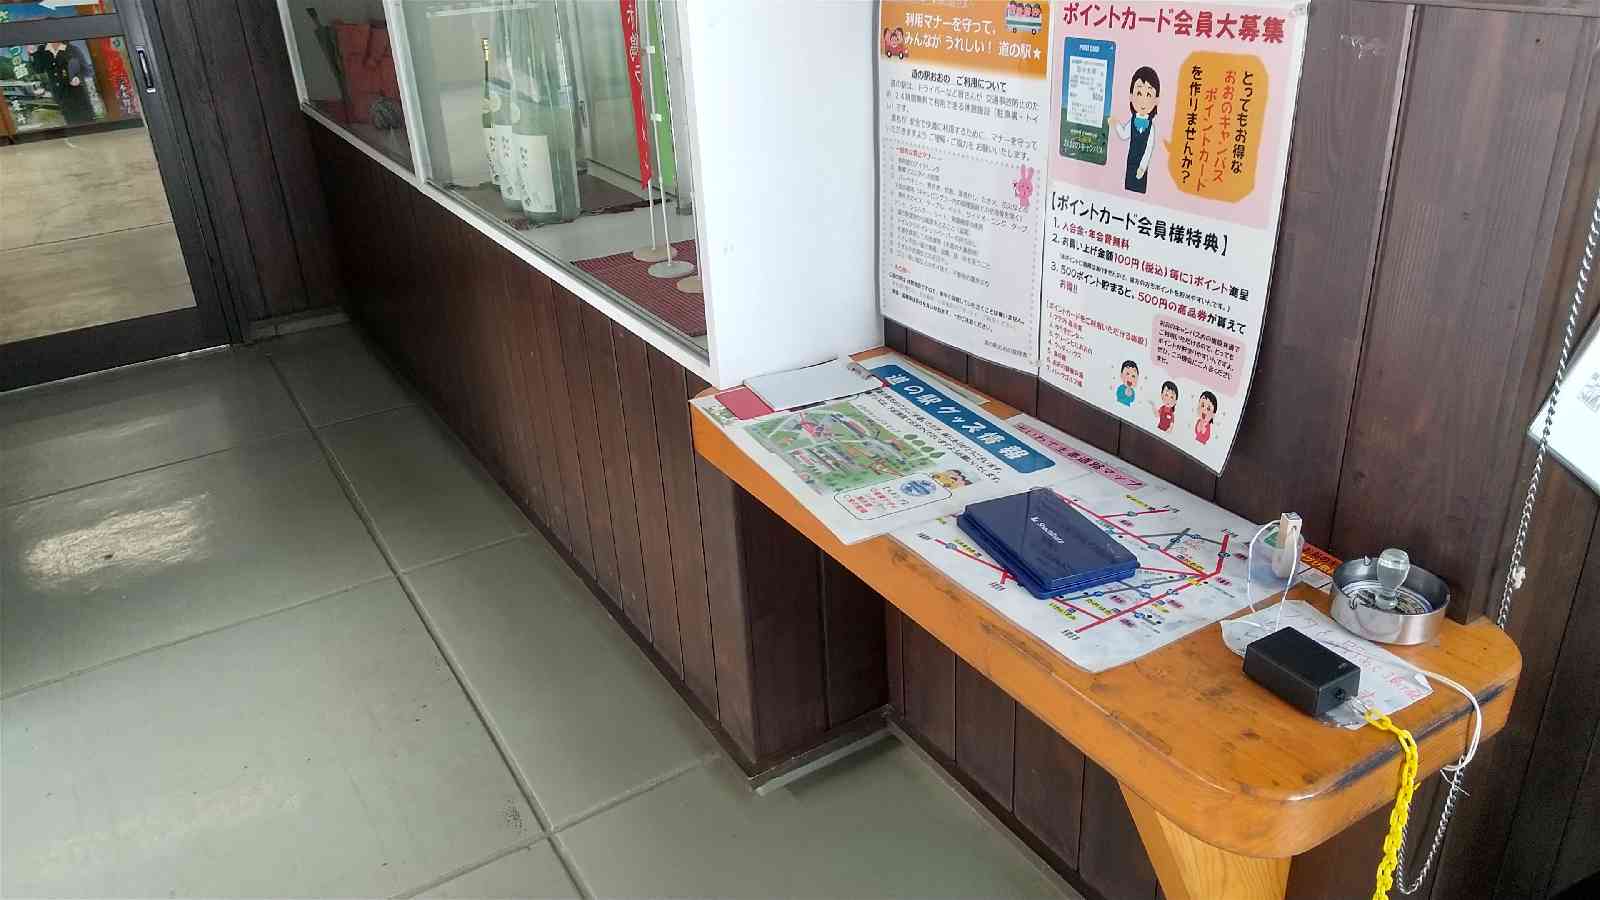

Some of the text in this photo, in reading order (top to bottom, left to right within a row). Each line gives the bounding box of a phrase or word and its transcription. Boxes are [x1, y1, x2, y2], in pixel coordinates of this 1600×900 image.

[905, 32, 942, 49] みんなが
[1063, 3, 1285, 44] ポイントカード会員大募集
[911, 69, 1007, 93] 道の駅おおの ご利用について
[1181, 65, 1203, 184] を作りませんか？
[1214, 71, 1236, 183] おおのキャンパス
[1231, 71, 1254, 175] とってもお得な
[1051, 191, 1228, 257] 【ポイントカード会員様特典】
[1062, 222, 1130, 251] 入会金・年会費無料
